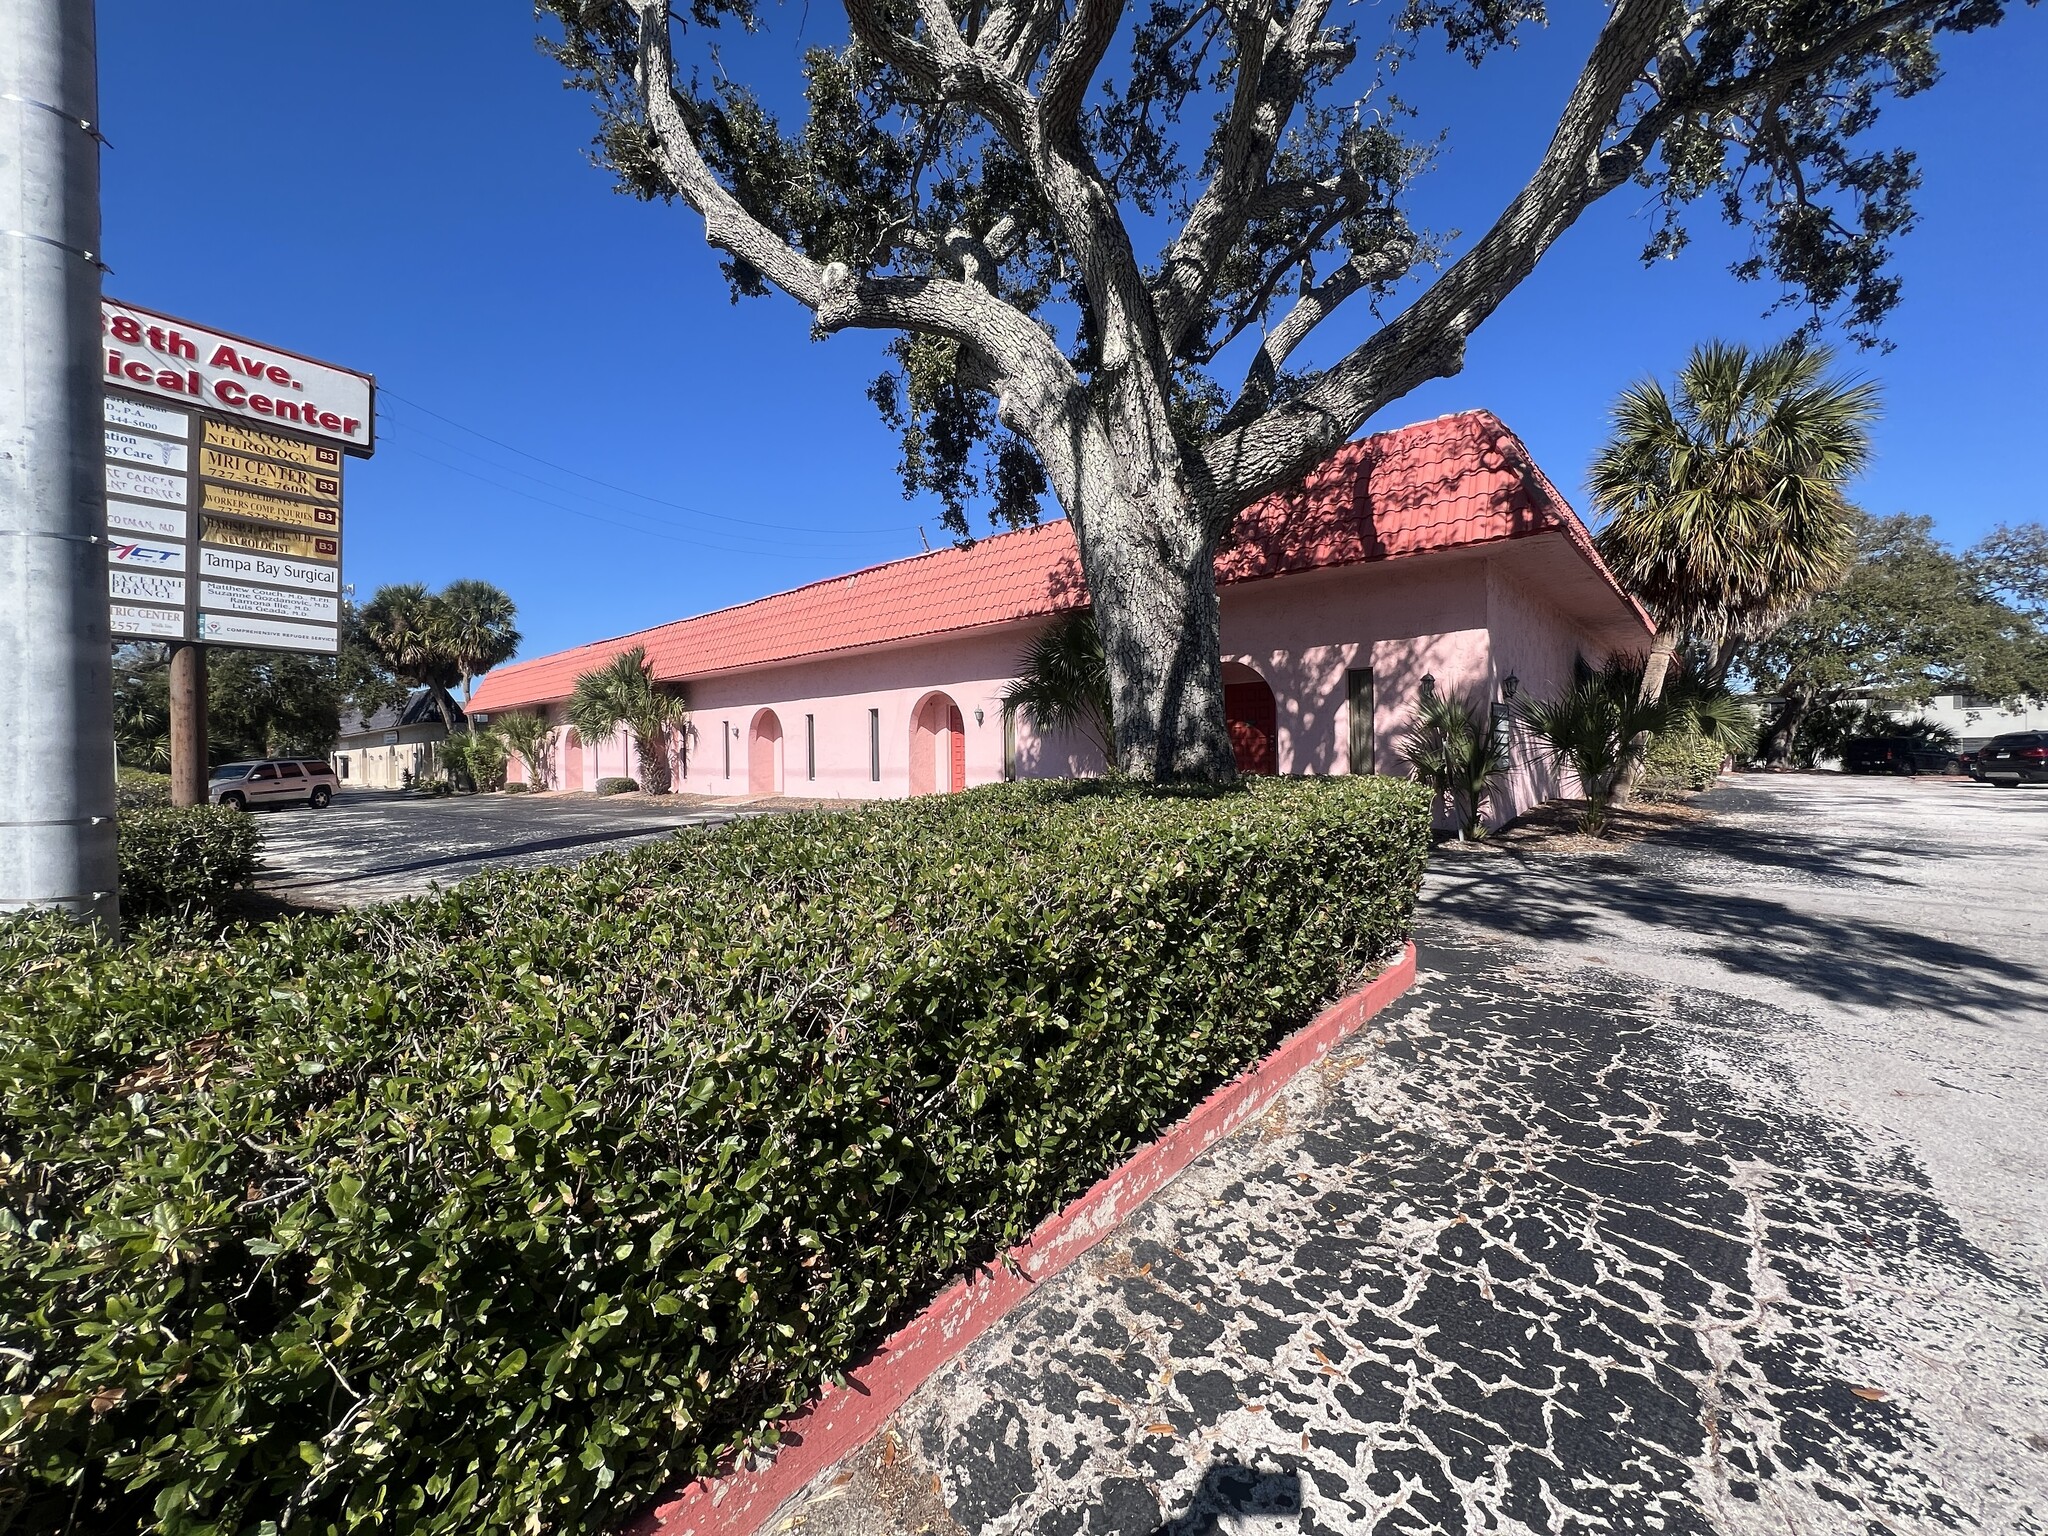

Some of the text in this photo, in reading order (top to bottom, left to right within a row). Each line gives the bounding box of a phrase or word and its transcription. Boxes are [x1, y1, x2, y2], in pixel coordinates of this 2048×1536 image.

[101, 313, 302, 389] 8th Ave.
[214, 379, 360, 434] Center
[109, 414, 158, 431] 344-5000
[208, 420, 309, 450] WEST COAST
[123, 447, 154, 461] Care
[208, 433, 311, 463] NEUROLOGY
[319, 451, 334, 461] B3
[208, 452, 308, 485] MRI CENTER
[208, 468, 307, 494] 727-345-7600
[319, 481, 334, 491] B3
[222, 487, 245, 498] AUTO
[247, 491, 291, 506] ACCIDENTS
[206, 494, 249, 510] WORKERS
[277, 507, 313, 521] INJURIES
[318, 511, 333, 521] B3
[221, 534, 290, 553] NEUROLOGIST
[319, 542, 334, 551] B3
[205, 553, 334, 583] Tampa Bay Surgical
[112, 574, 184, 588] FACETIME
[112, 580, 168, 593] BEAUTY
[112, 586, 174, 599] LOUNGE
[207, 583, 250, 594] Matthew
[208, 588, 252, 599] Suzanne
[231, 597, 271, 607] Ramona
[233, 603, 253, 611] Luis
[138, 609, 180, 622] CENTER
[226, 628, 281, 637] COMPREHENSIVE
[282, 632, 309, 640] REFUGEE
